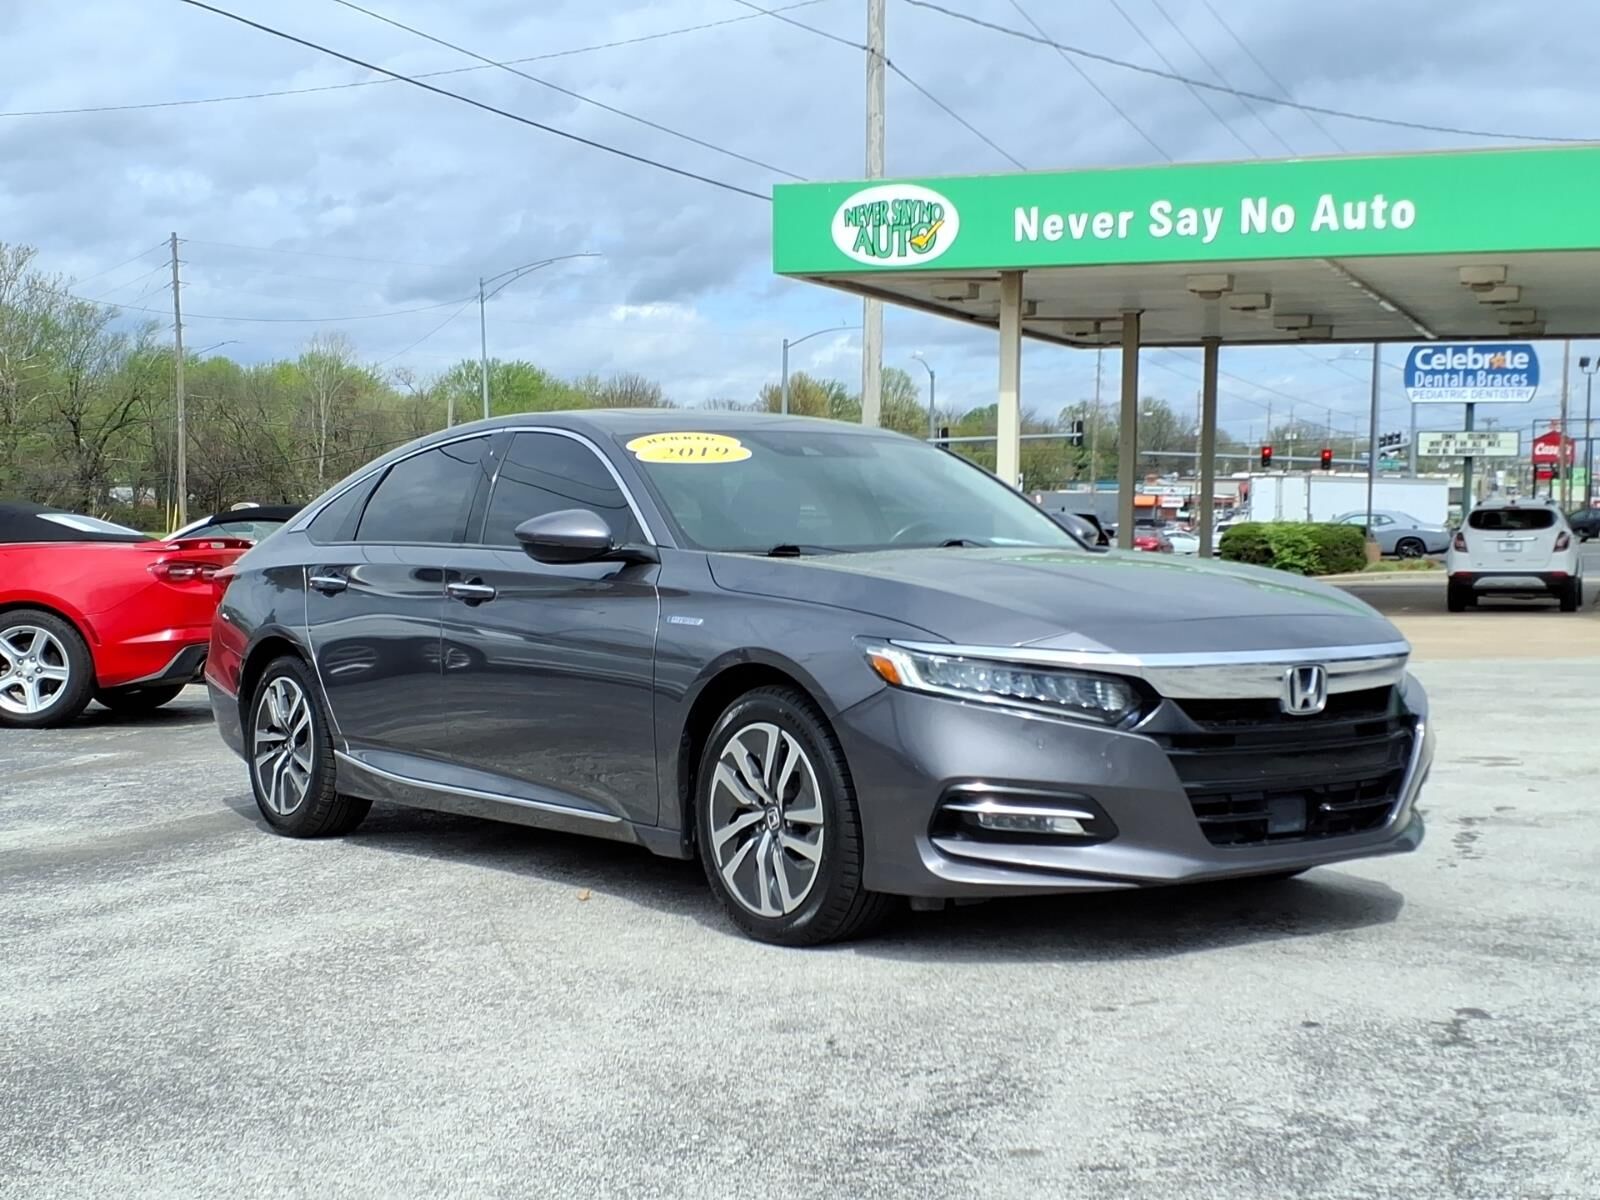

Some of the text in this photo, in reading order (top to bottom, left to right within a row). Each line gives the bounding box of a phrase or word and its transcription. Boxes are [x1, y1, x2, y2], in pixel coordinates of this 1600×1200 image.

[844, 199, 945, 228] NEVER SAY NO
[1014, 193, 1417, 244] Never Say No Auto
[852, 222, 937, 258] AUTO
[1415, 348, 1529, 370] Celebrte
[1414, 371, 1463, 387] Dental
[1476, 371, 1528, 387] Braces
[1412, 389, 1531, 399] PEDIATRIC DENTISTRY
[662, 446, 730, 459] 2019
